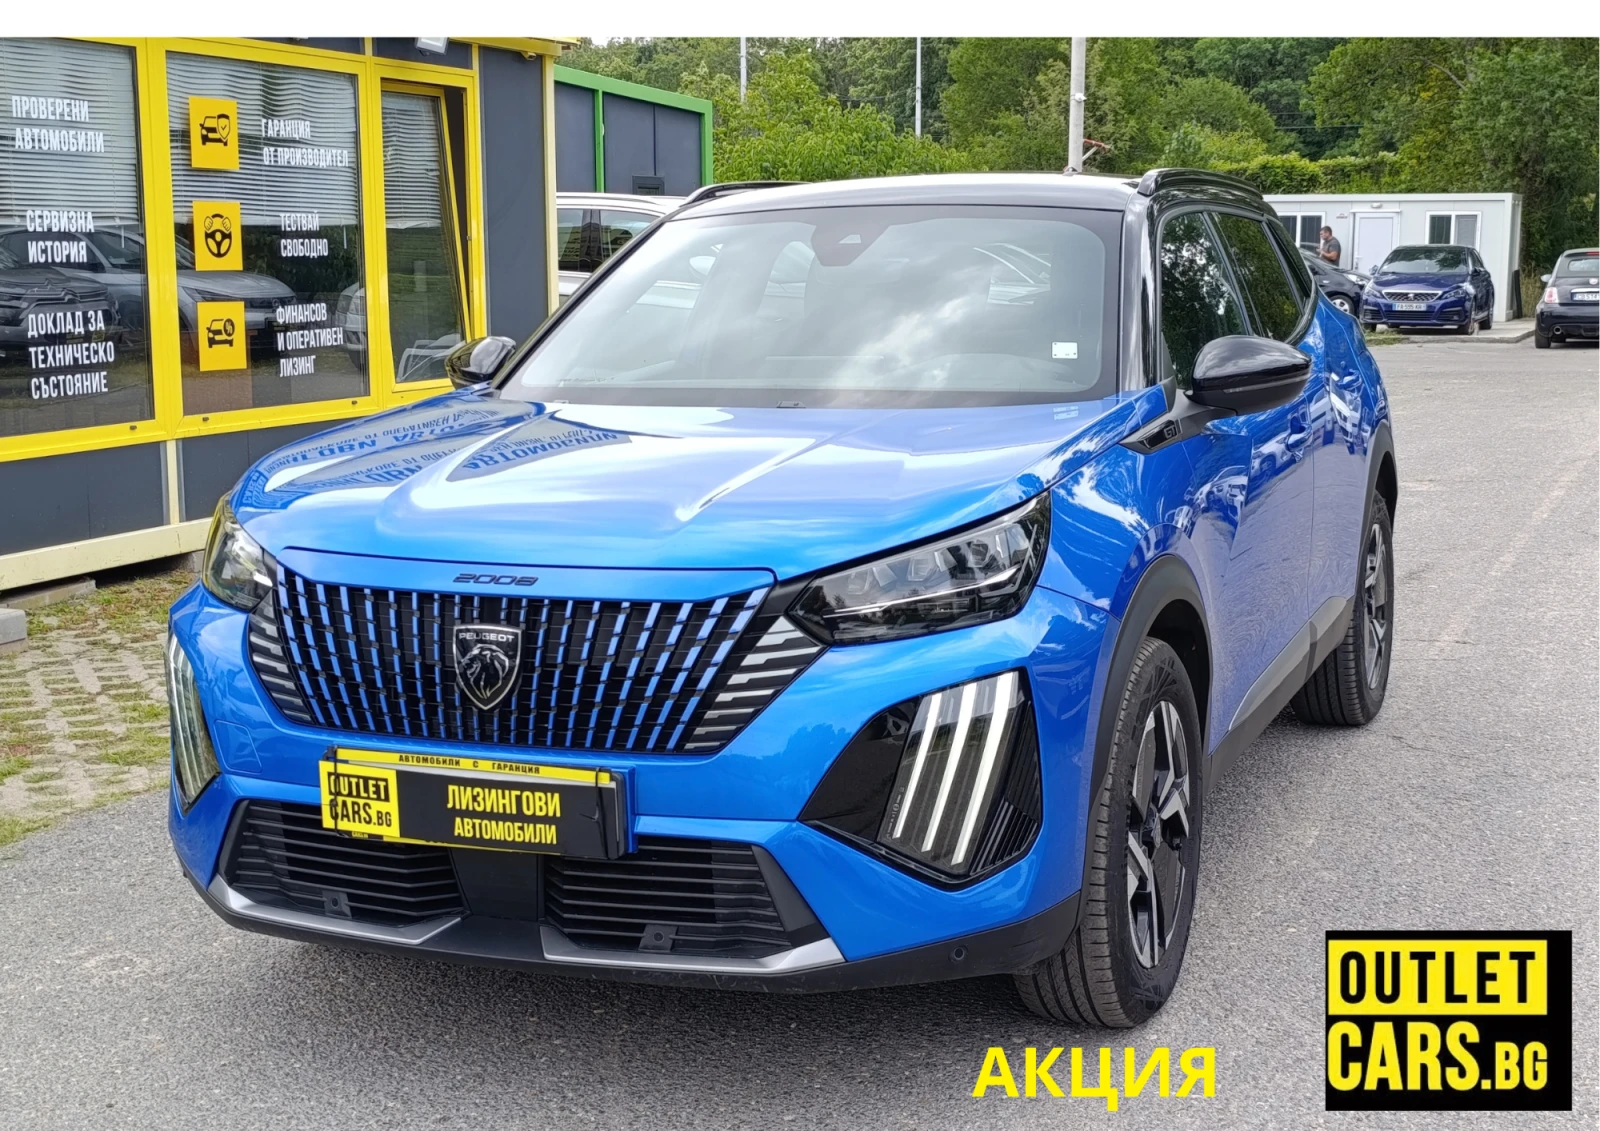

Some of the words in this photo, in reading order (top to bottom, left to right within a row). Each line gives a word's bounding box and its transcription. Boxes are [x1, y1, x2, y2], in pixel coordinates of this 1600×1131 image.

[11, 95, 90, 122] ПРОВЕРЕНИ
[15, 127, 105, 153] АВТОМОБИЛИ
[262, 119, 311, 139] ГАРАНЦИЯ
[263, 147, 277, 165] ОТ
[278, 148, 349, 168] ПРОИЗВОДИТЕЛ
[26, 210, 95, 234] СЕРВИЗНА
[280, 210, 320, 232] ТЕСТВАЙ
[27, 240, 87, 263] ИСТОРИЯ
[280, 238, 329, 258] СВОБОДНО
[27, 312, 85, 338] ДОКЛАД
[87, 310, 105, 331] ЗА
[276, 302, 328, 325] ФИНАНСОВ
[277, 331, 286, 352] И
[286, 327, 344, 350] ОПЕРАТИВЕН
[29, 341, 115, 369] ТЕХНИЧЕСКО
[280, 354, 316, 377] ЛИЗИНГ
[31, 371, 108, 400] СЪСТОЯНИЕ
[453, 573, 539, 586] 2008
[459, 632, 515, 642] PEUGEOT
[399, 754, 461, 767] АВТОМОБИЛИ
[472, 760, 479, 768] С
[492, 762, 541, 775] ГАРАНЦИЯ
[329, 774, 387, 800] OUTLET
[447, 784, 561, 817] ЛИЗИНГОВИ
[329, 799, 392, 827] CARS.BG
[454, 816, 557, 844] АВТОМОБИЛИ
